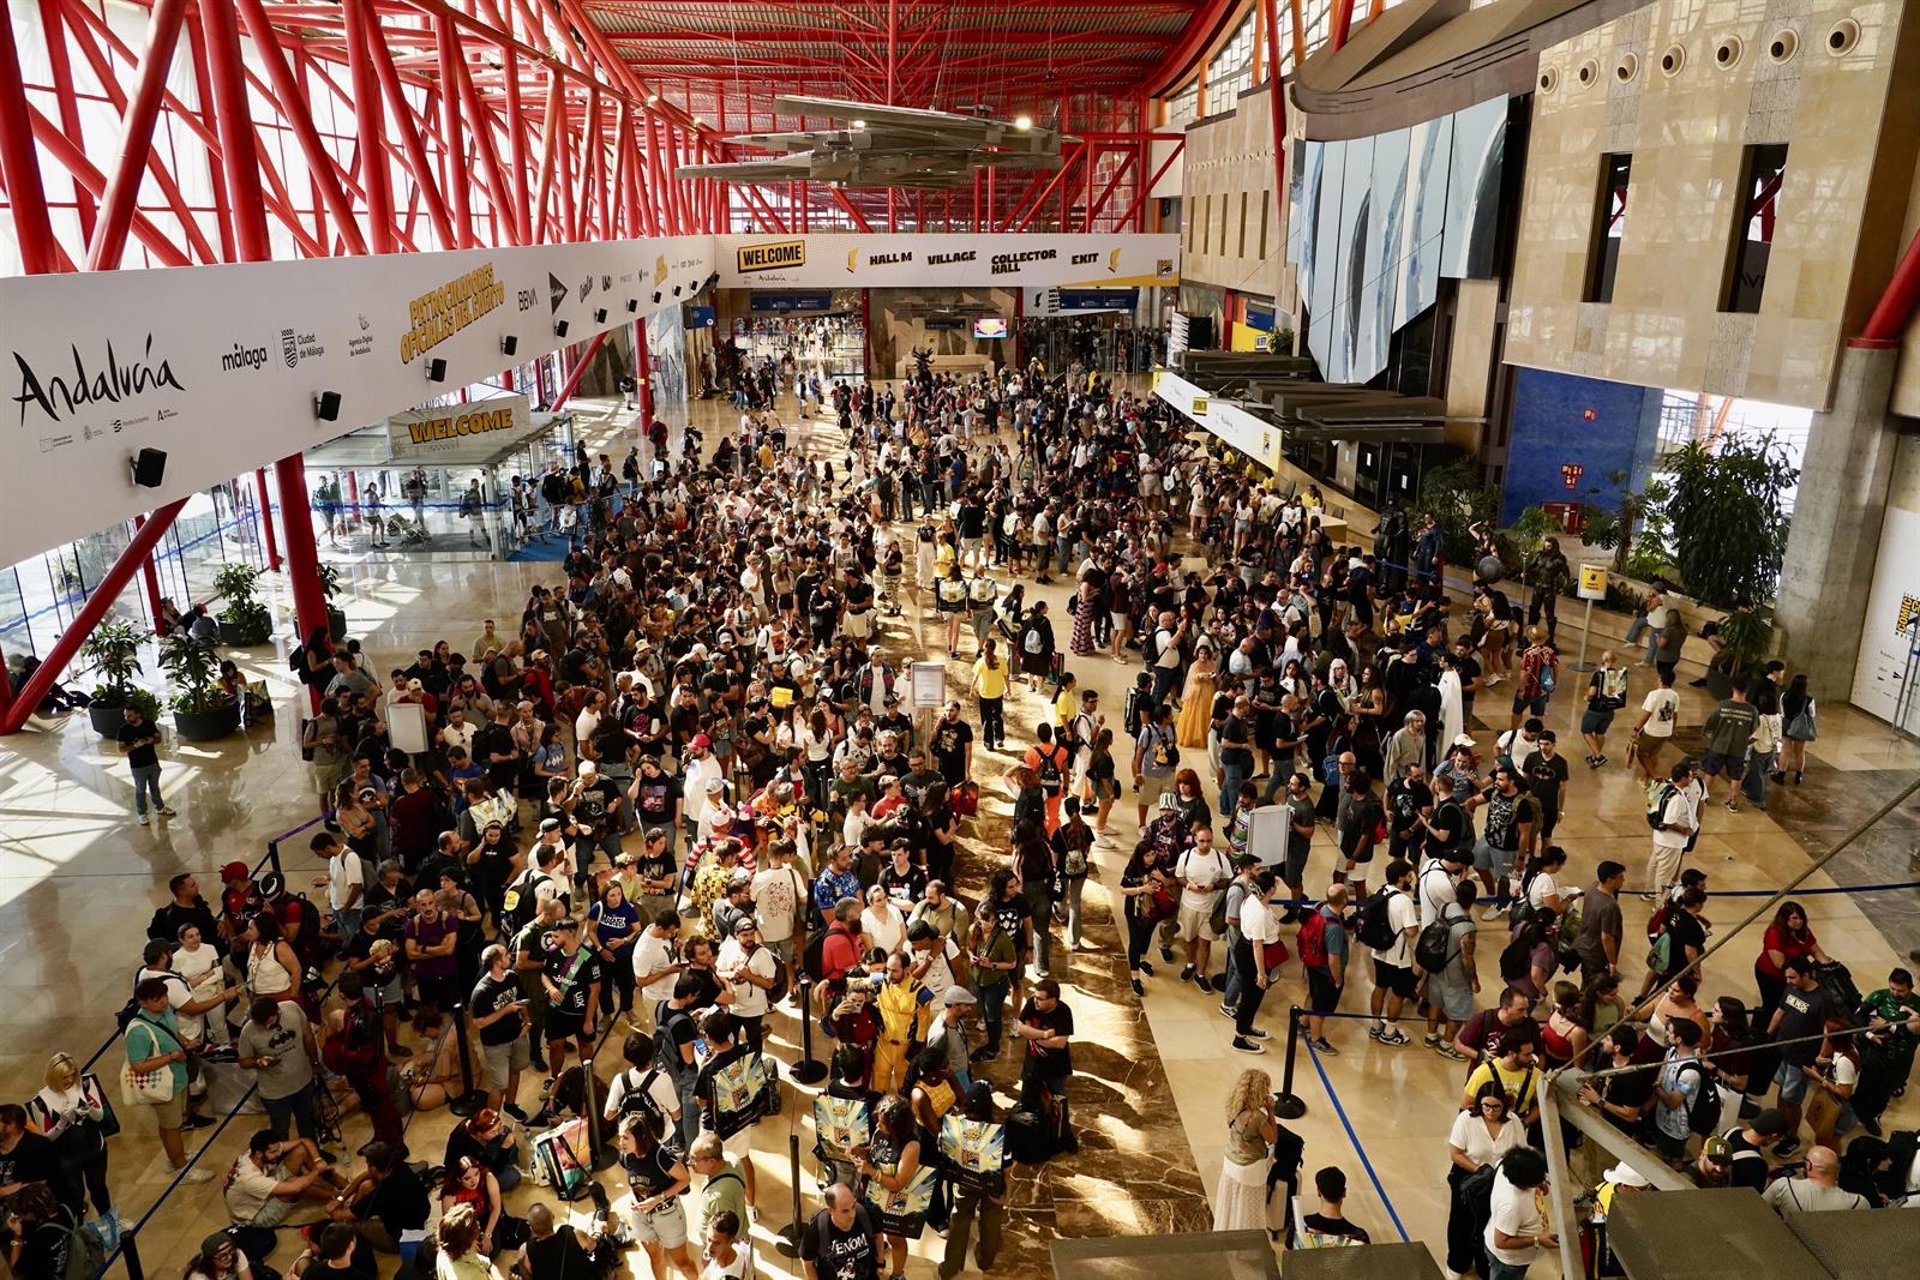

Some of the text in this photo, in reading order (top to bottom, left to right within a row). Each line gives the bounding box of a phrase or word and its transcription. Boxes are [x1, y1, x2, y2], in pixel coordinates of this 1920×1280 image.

[743, 245, 801, 266] WELCOME
[870, 252, 912, 265] HALL M
[927, 251, 976, 265] VILLAGE
[991, 249, 1056, 265] COLLECTOR
[1071, 252, 1099, 265] EXIT
[991, 263, 1021, 275] HALL
[518, 288, 538, 312] BBVA
[297, 333, 316, 345] Ciudad
[221, 343, 267, 371] málaga
[12, 331, 186, 428] Andalucía
[409, 409, 513, 444] WELCOME
[1896, 597, 1912, 633] COMIC
